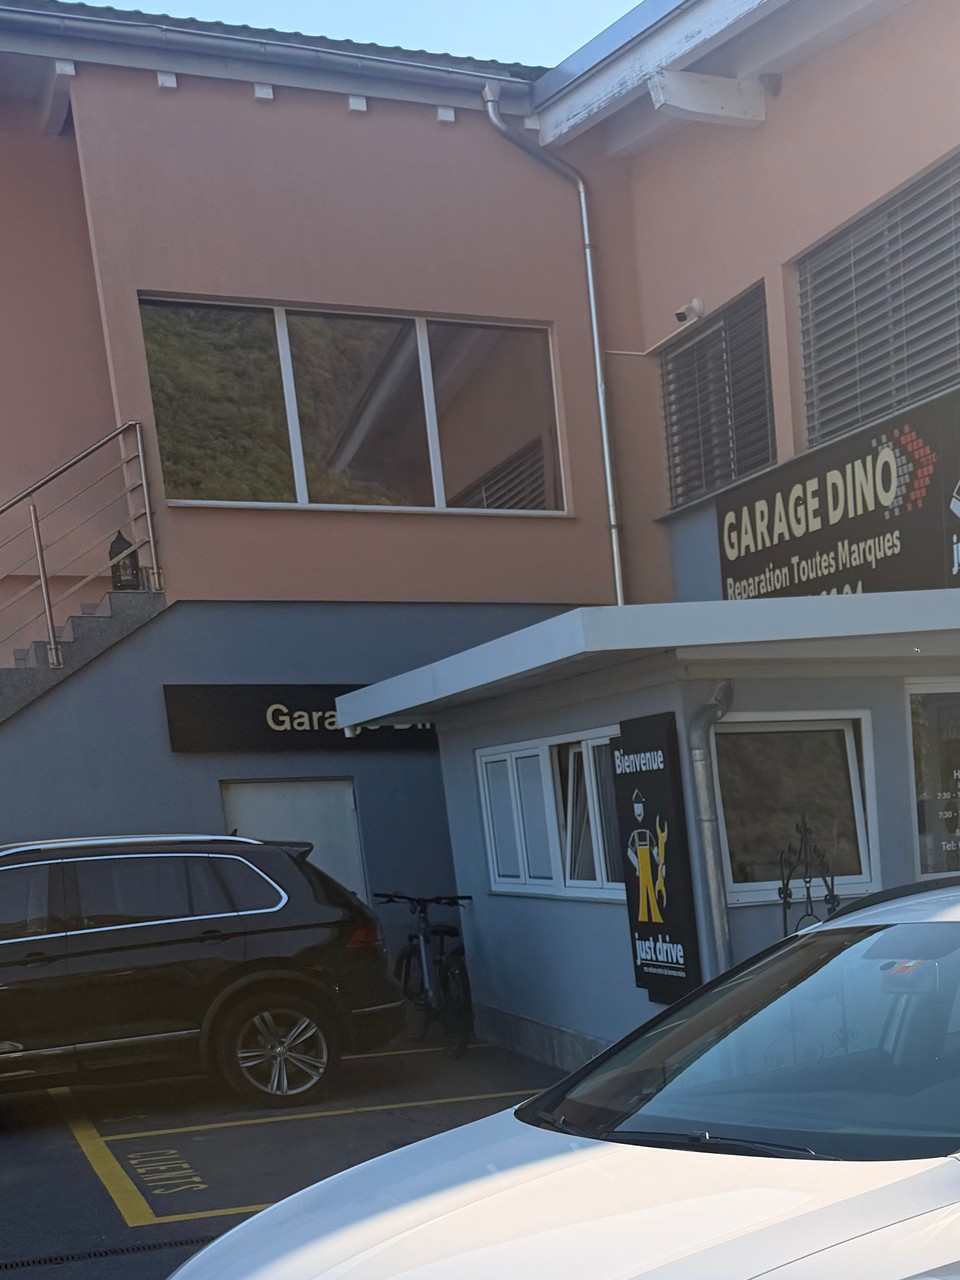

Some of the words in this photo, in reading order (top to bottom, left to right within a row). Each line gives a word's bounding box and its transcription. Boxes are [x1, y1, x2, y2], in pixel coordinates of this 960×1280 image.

[723, 476, 822, 562] GARAGE
[826, 447, 898, 526] DINO
[727, 563, 790, 600] Reparation
[791, 550, 836, 584] Toutes
[837, 529, 901, 569] Marques
[614, 748, 665, 775] Bienvenue
[634, 931, 656, 966] just
[656, 934, 685, 965] drive
[127, 1149, 209, 1195] CLIENTS
